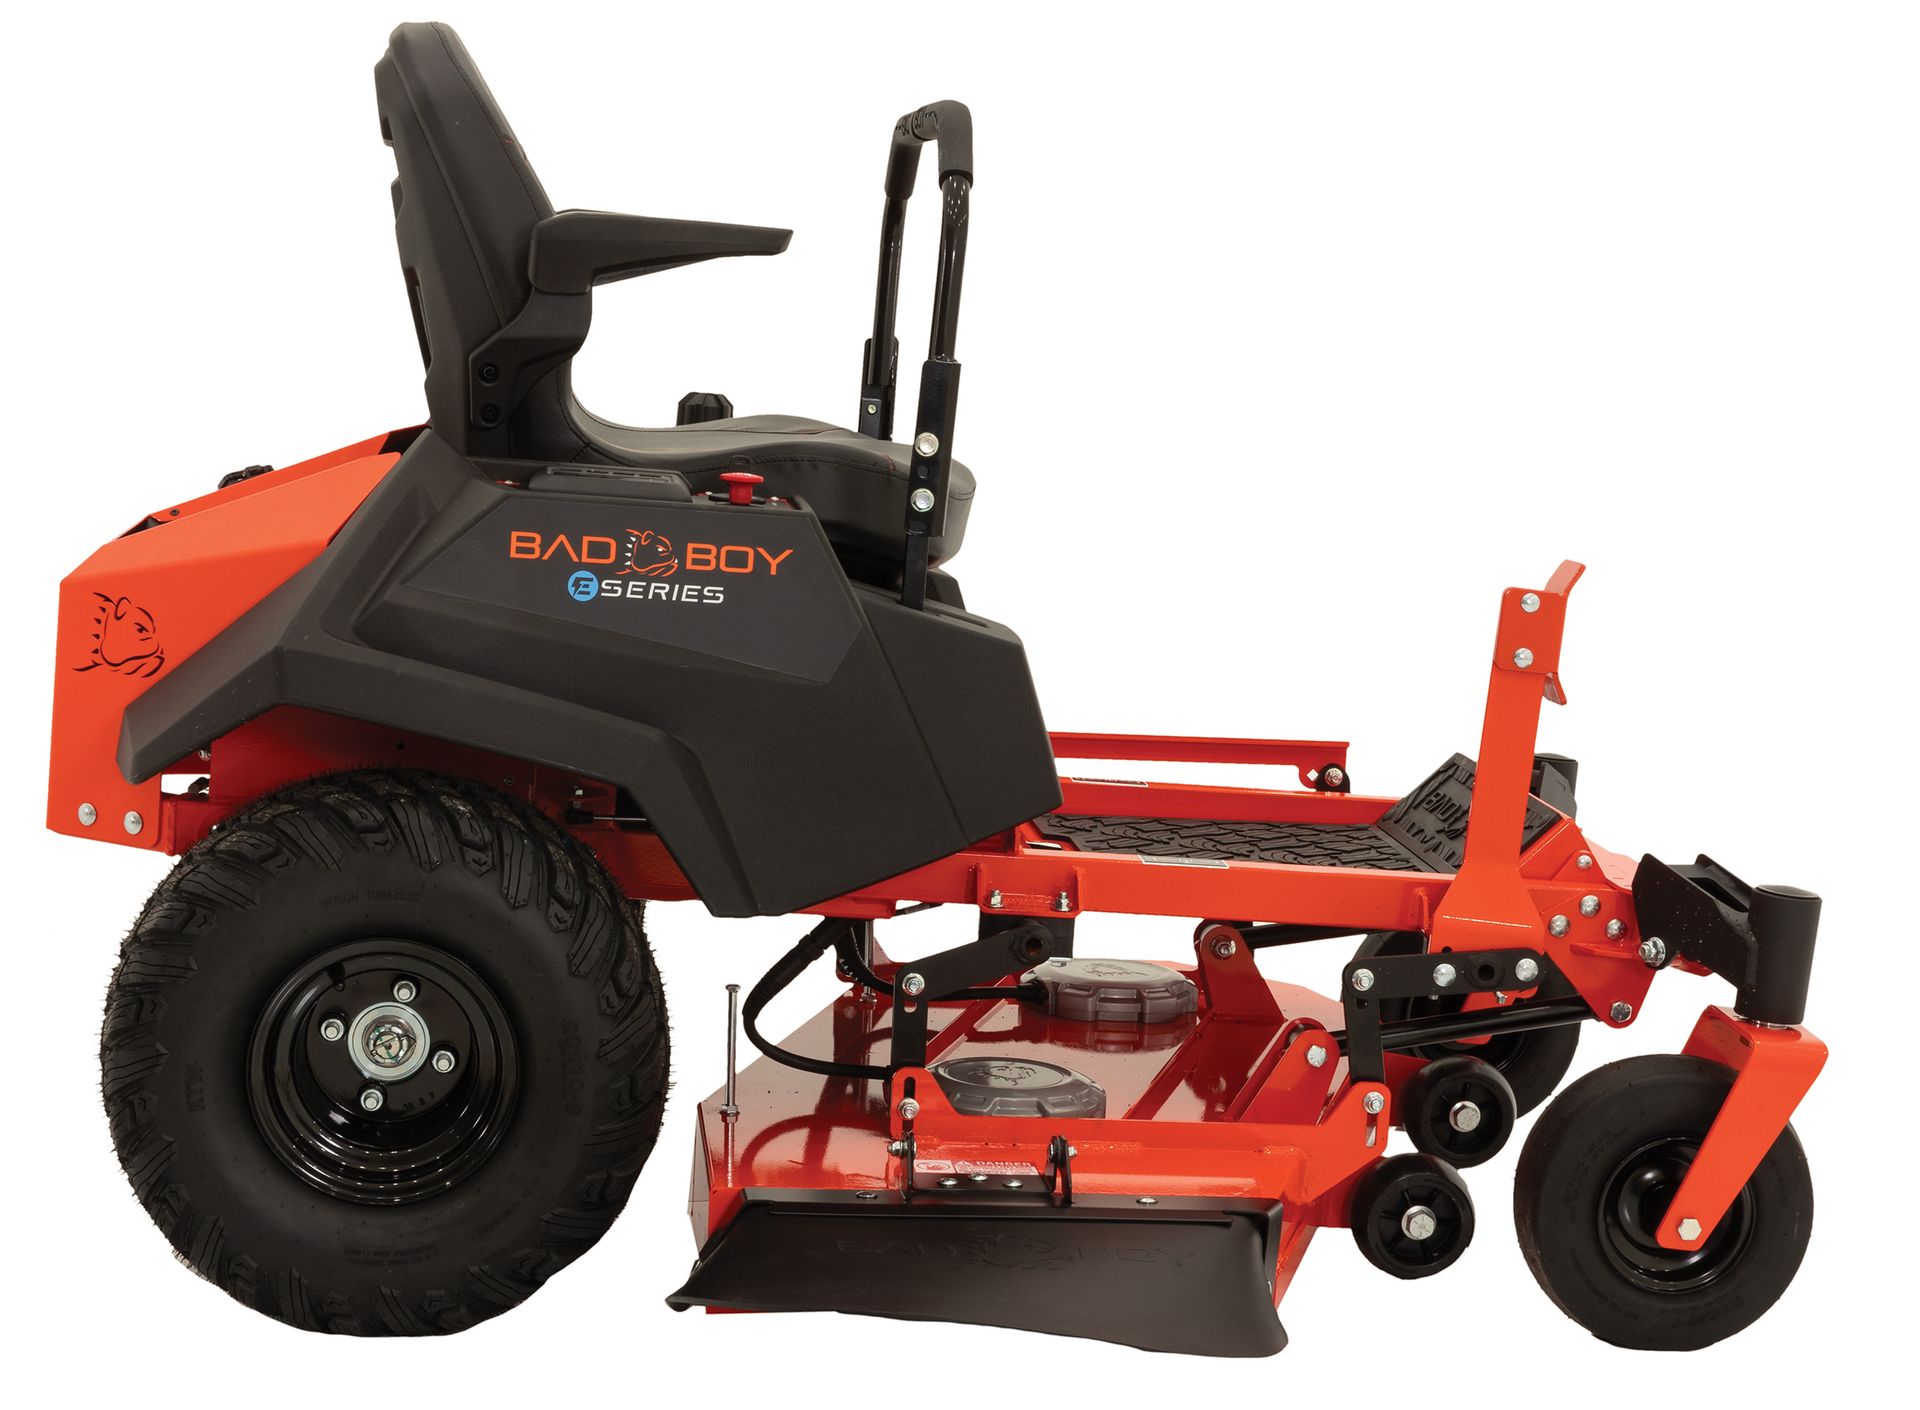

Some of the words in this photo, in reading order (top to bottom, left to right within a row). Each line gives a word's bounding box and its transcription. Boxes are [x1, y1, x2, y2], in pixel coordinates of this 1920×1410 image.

[509, 530, 617, 565] BAD
[685, 542, 794, 576] BOY
[600, 579, 724, 604] SERIES
